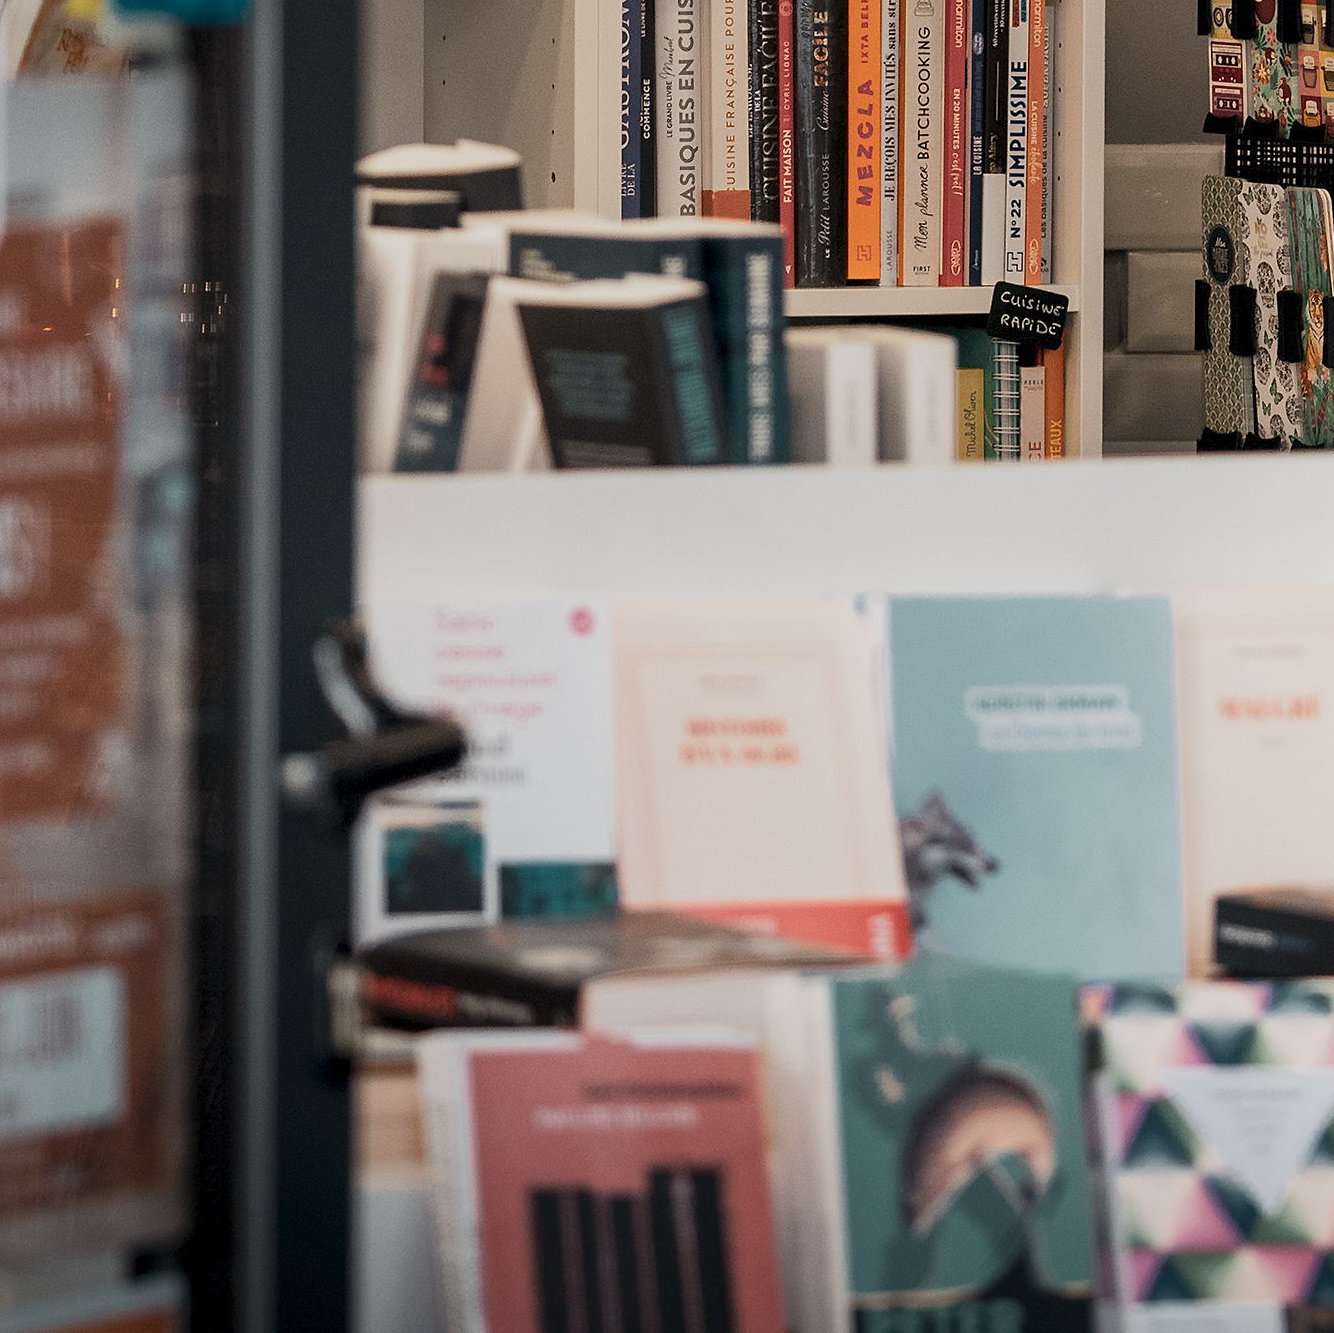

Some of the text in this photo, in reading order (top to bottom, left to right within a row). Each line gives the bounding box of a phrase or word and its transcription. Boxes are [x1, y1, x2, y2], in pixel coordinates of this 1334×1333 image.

[860, 35, 868, 63] IXTA
[884, 20, 896, 51] sans
[678, 59, 694, 91] EN
[884, 53, 896, 102] INVITÉS
[916, 27, 930, 160] BATCHCOOKING
[643, 79, 651, 140] COMMENCE
[884, 105, 896, 132] MES
[1008, 61, 1027, 187] SIMPLISSIME
[679, 97, 697, 217] BASIQUES
[783, 129, 792, 203] FAIT MAISON
[856, 79, 874, 207] MEZCLA
[884, 137, 896, 182] REÇOIS
[884, 186, 896, 202] JE
[914, 220, 928, 252] Mon
